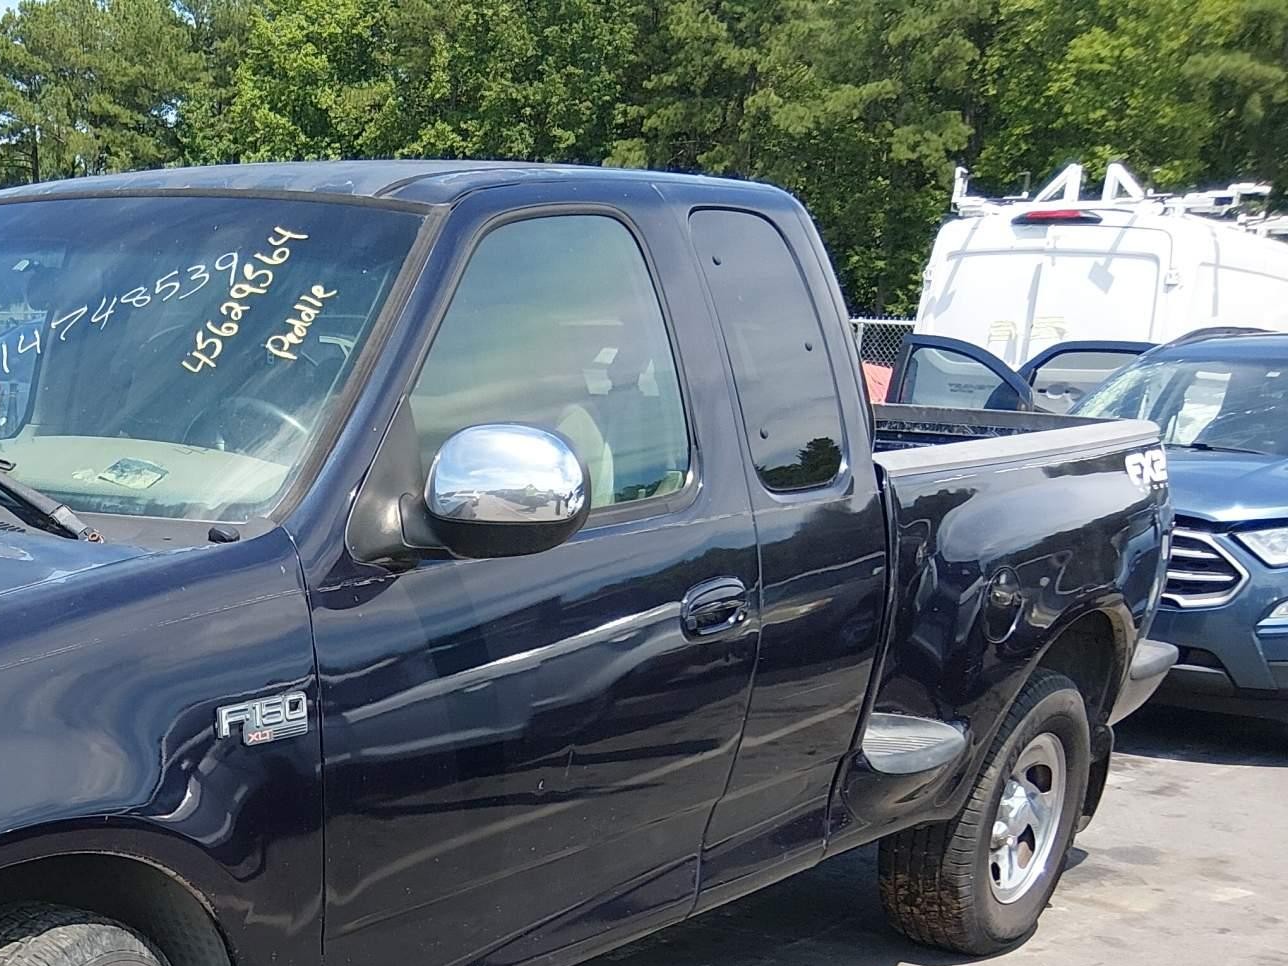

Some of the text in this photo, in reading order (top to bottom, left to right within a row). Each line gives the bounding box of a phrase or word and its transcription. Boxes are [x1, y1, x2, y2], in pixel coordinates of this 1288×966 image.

[2, 250, 238, 373] 14748539
[182, 226, 309, 373] 45629564
[247, 730, 273, 744] XLT
